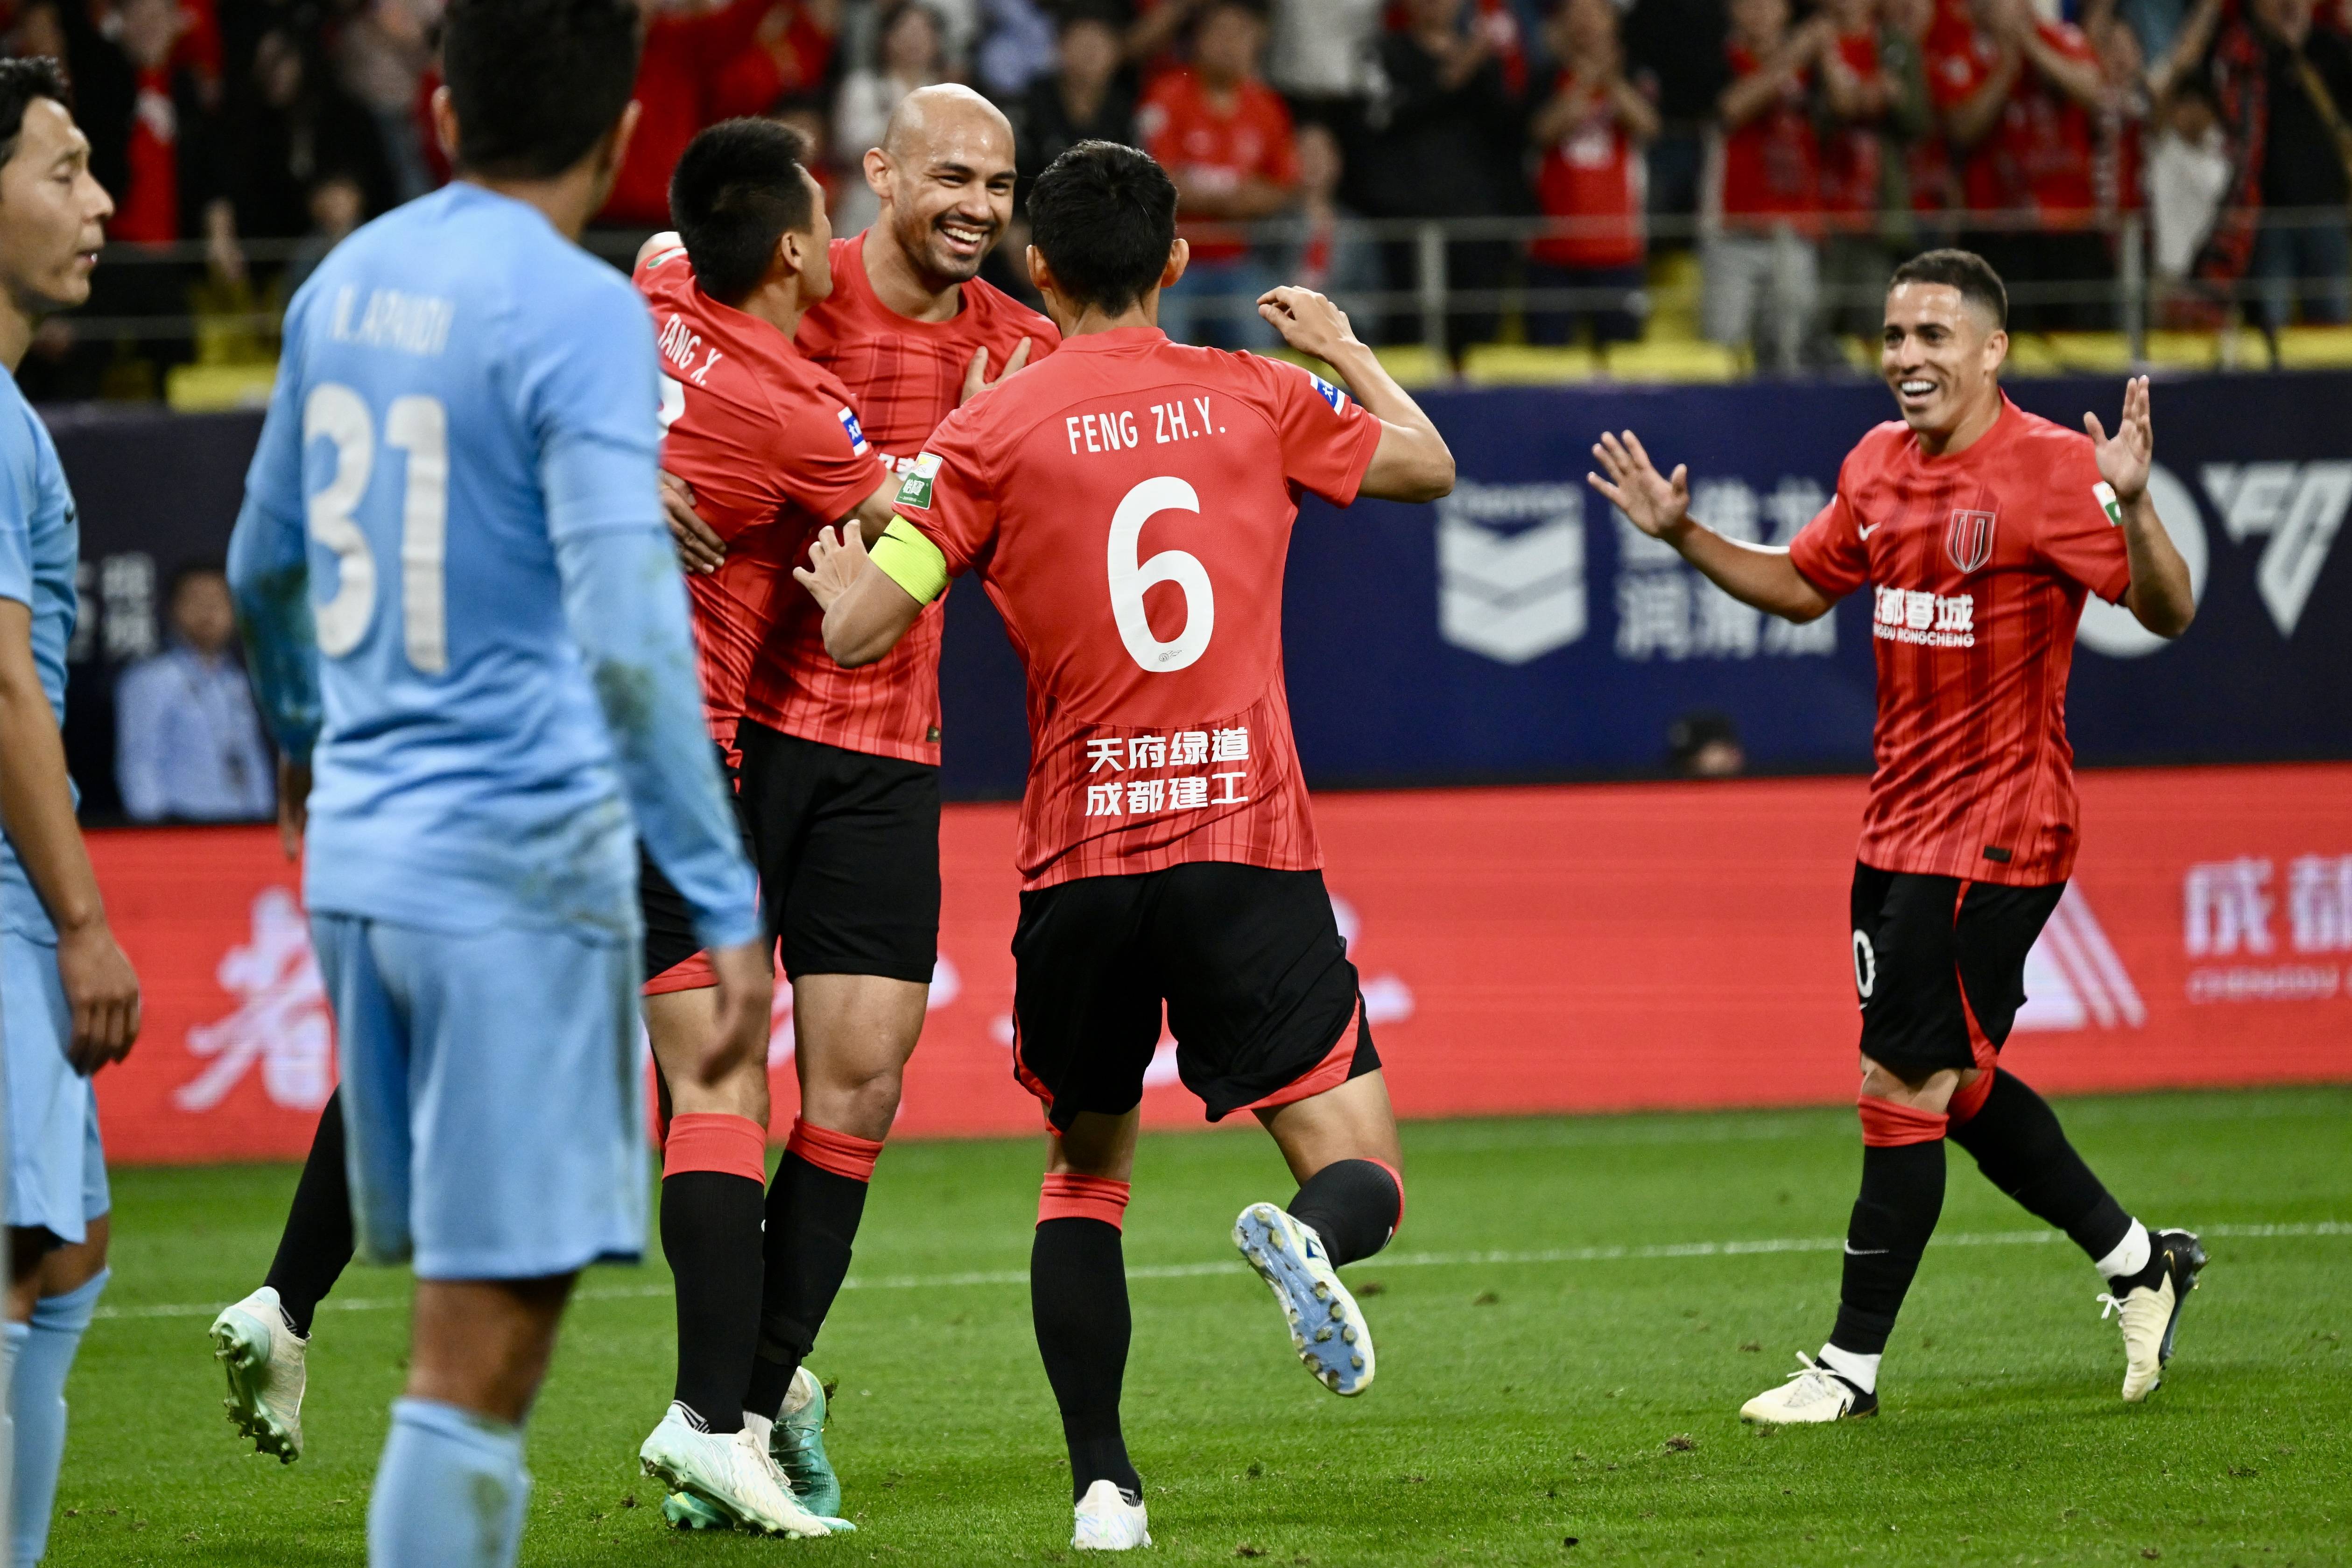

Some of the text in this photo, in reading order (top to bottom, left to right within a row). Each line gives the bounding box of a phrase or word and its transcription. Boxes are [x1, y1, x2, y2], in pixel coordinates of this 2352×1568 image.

[657, 313, 723, 387] TANG X.
[1066, 396, 1226, 455] FENG ZH.Y.
[303, 382, 449, 675] 31
[1107, 476, 1214, 672] 6
[1897, 628, 1975, 647] RONGCHENG
[1086, 726, 1249, 773] 天府绿道
[1085, 772, 1249, 816] 成都建工
